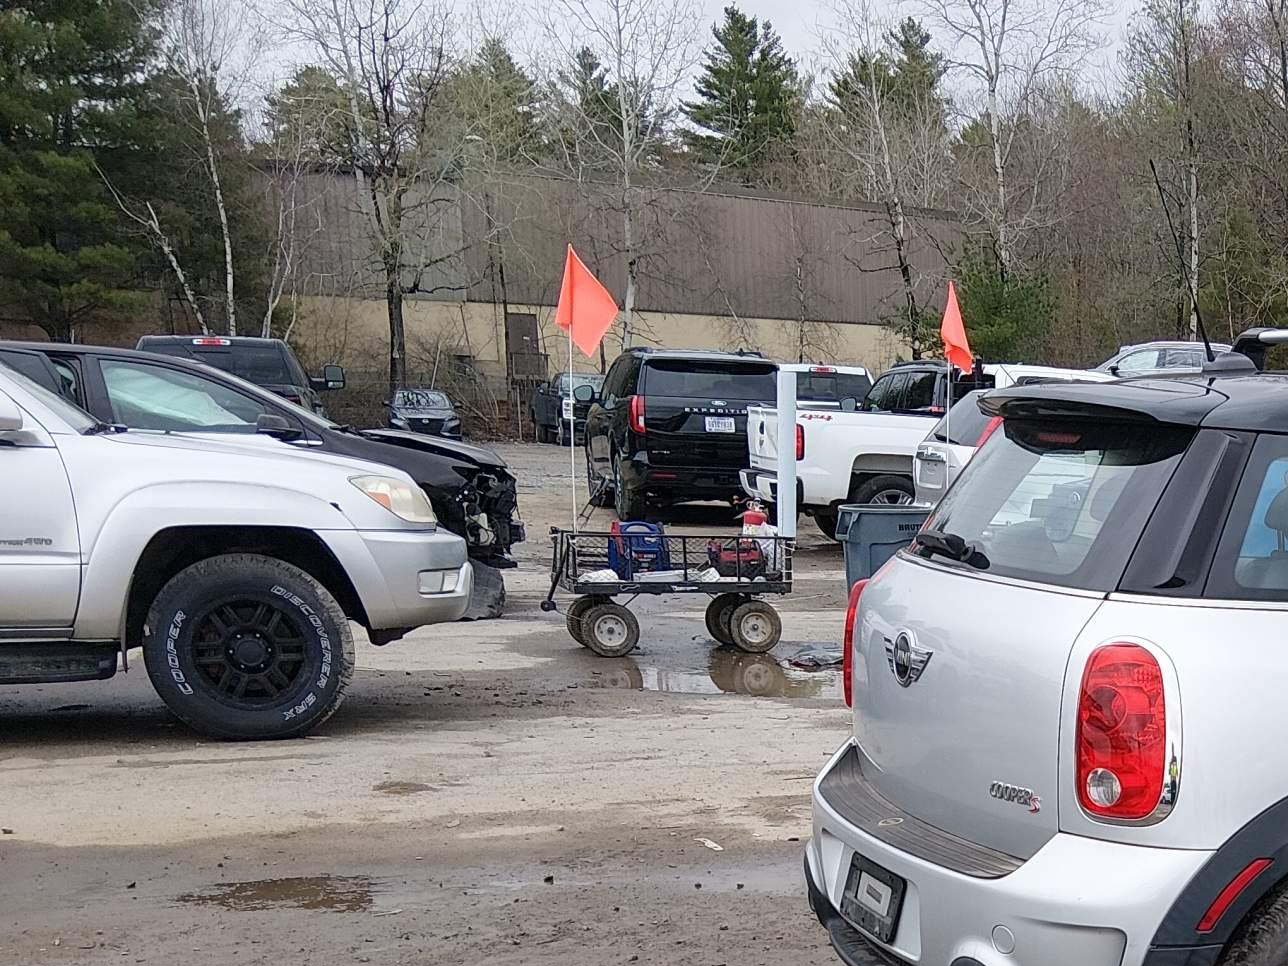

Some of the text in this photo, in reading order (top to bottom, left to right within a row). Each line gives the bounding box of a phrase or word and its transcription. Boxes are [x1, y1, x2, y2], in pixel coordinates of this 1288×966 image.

[166, 610, 193, 695] COOPER
[270, 585, 332, 721] DISCOVERER SRX
[990, 781, 1041, 813] COOPER S
